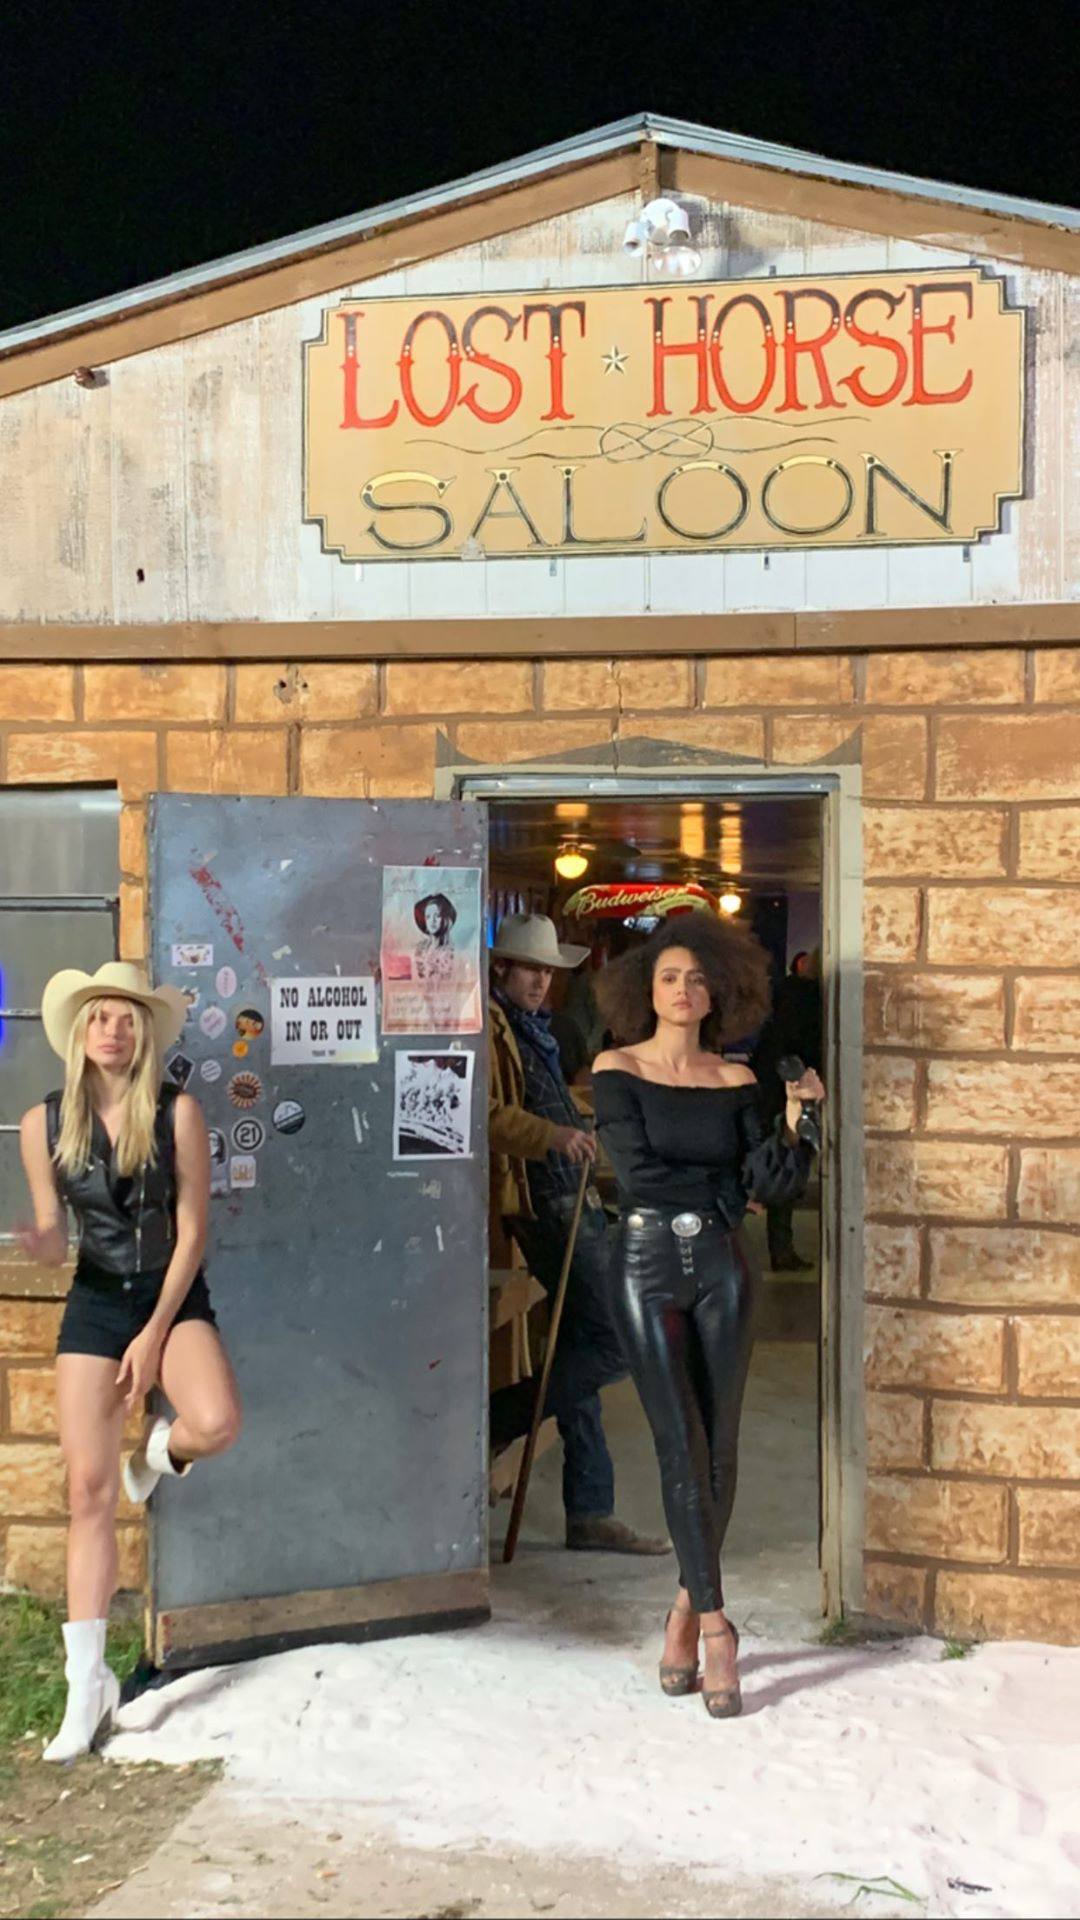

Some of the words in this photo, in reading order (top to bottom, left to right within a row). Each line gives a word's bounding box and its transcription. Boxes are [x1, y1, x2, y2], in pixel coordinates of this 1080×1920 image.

[335, 301, 586, 430] LOST
[643, 281, 975, 417] HORSE
[359, 448, 962, 551] SALOON
[575, 885, 689, 921] Budweiser
[280, 987, 299, 1008] NO
[307, 986, 368, 1008] ALCOHOL
[285, 1021, 302, 1042] IN
[310, 1020, 329, 1041] OR
[336, 1019, 362, 1040] OUT
[240, 1126, 257, 1143] 21
